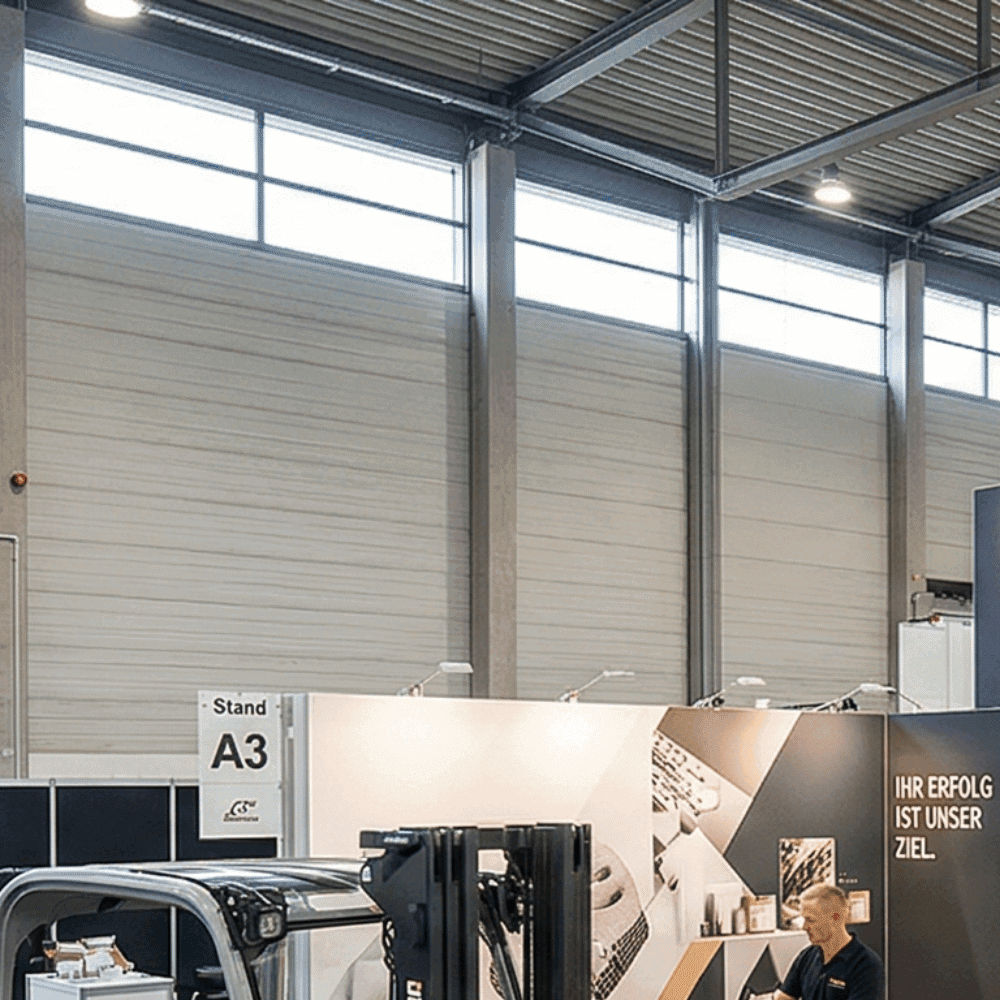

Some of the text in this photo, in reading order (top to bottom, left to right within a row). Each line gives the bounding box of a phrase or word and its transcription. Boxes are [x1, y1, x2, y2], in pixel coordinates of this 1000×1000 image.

[213, 697, 267, 715] Stand
[210, 733, 268, 769] A3
[895, 774, 993, 799] IHR ERFOLG
[895, 805, 983, 829] IST UNSER
[895, 836, 936, 859] ZIEL.
